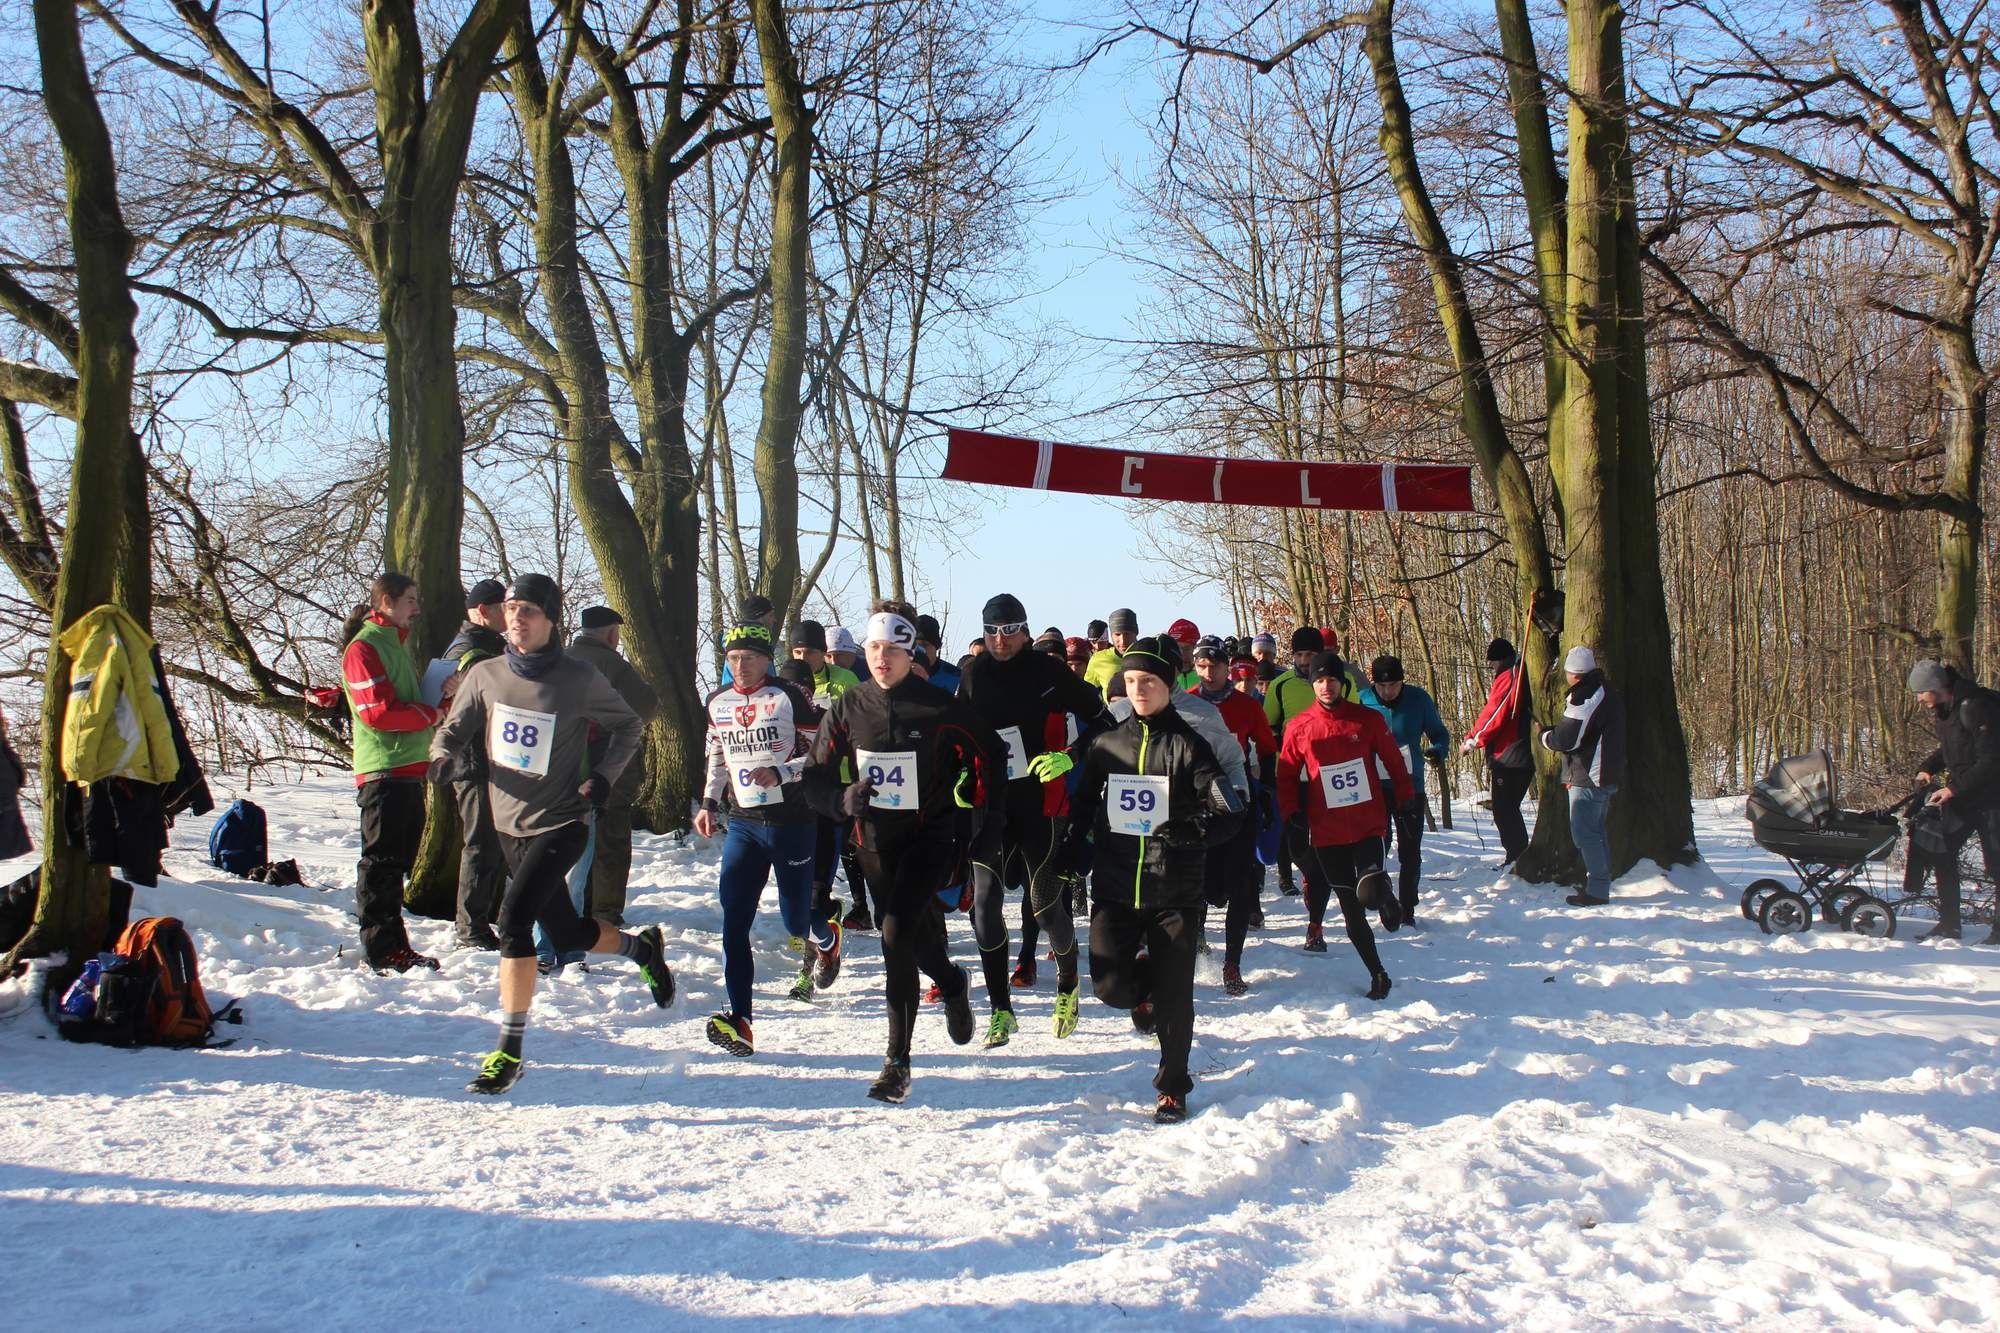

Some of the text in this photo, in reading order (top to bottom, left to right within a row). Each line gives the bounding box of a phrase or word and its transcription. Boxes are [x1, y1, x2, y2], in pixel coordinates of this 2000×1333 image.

[502, 721, 539, 747] 88
[721, 726, 779, 745] FACTOR
[868, 765, 905, 787] 94
[1331, 771, 1359, 790] 65
[1119, 789, 1156, 812] 59
